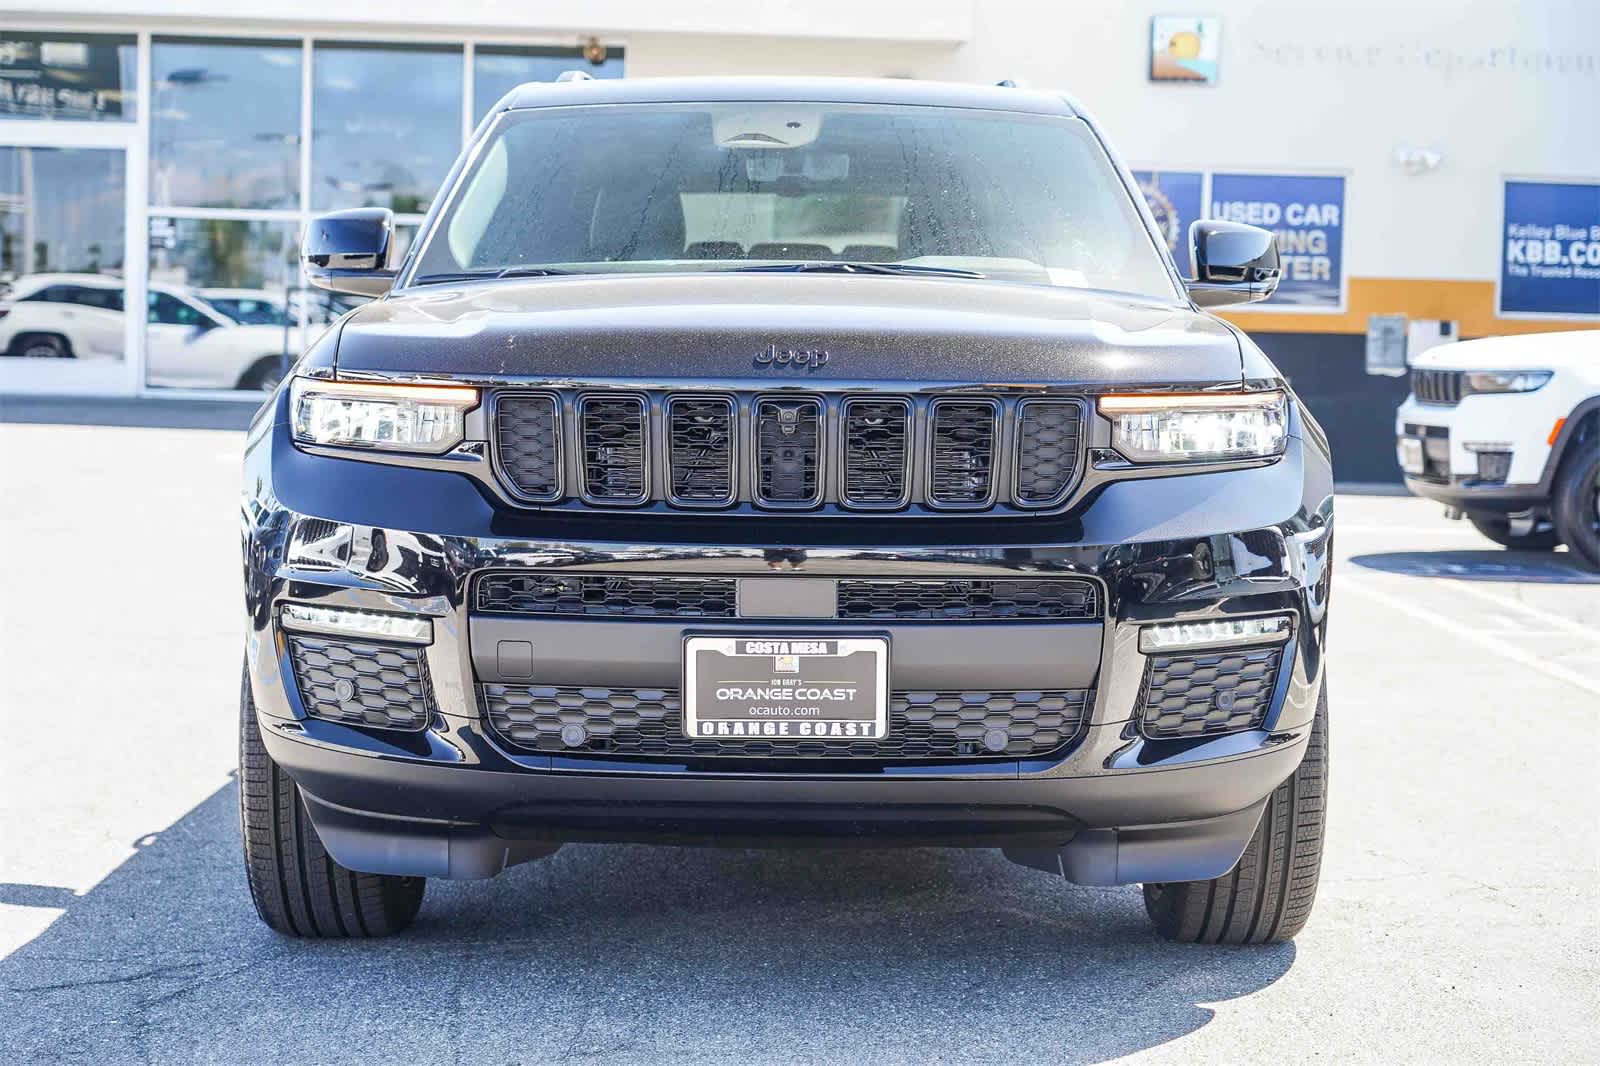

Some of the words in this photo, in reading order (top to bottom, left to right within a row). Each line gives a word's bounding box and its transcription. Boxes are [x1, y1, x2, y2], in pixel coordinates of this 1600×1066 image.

[1212, 201, 1281, 225] USED
[1286, 203, 1340, 226] CAR
[1508, 224, 1552, 240] Kelley
[1555, 224, 1587, 240] Blue
[1277, 230, 1328, 254] ING
[1281, 256, 1332, 280] TER
[752, 344, 830, 371] Jeep
[745, 641, 789, 655] COSTA
[791, 641, 828, 655] MESA
[716, 688, 793, 701] ORANGE
[795, 688, 857, 701] COAST
[749, 705, 820, 716] ocauto.com
[702, 722, 789, 736] ORANGE
[799, 722, 872, 736] COAST
